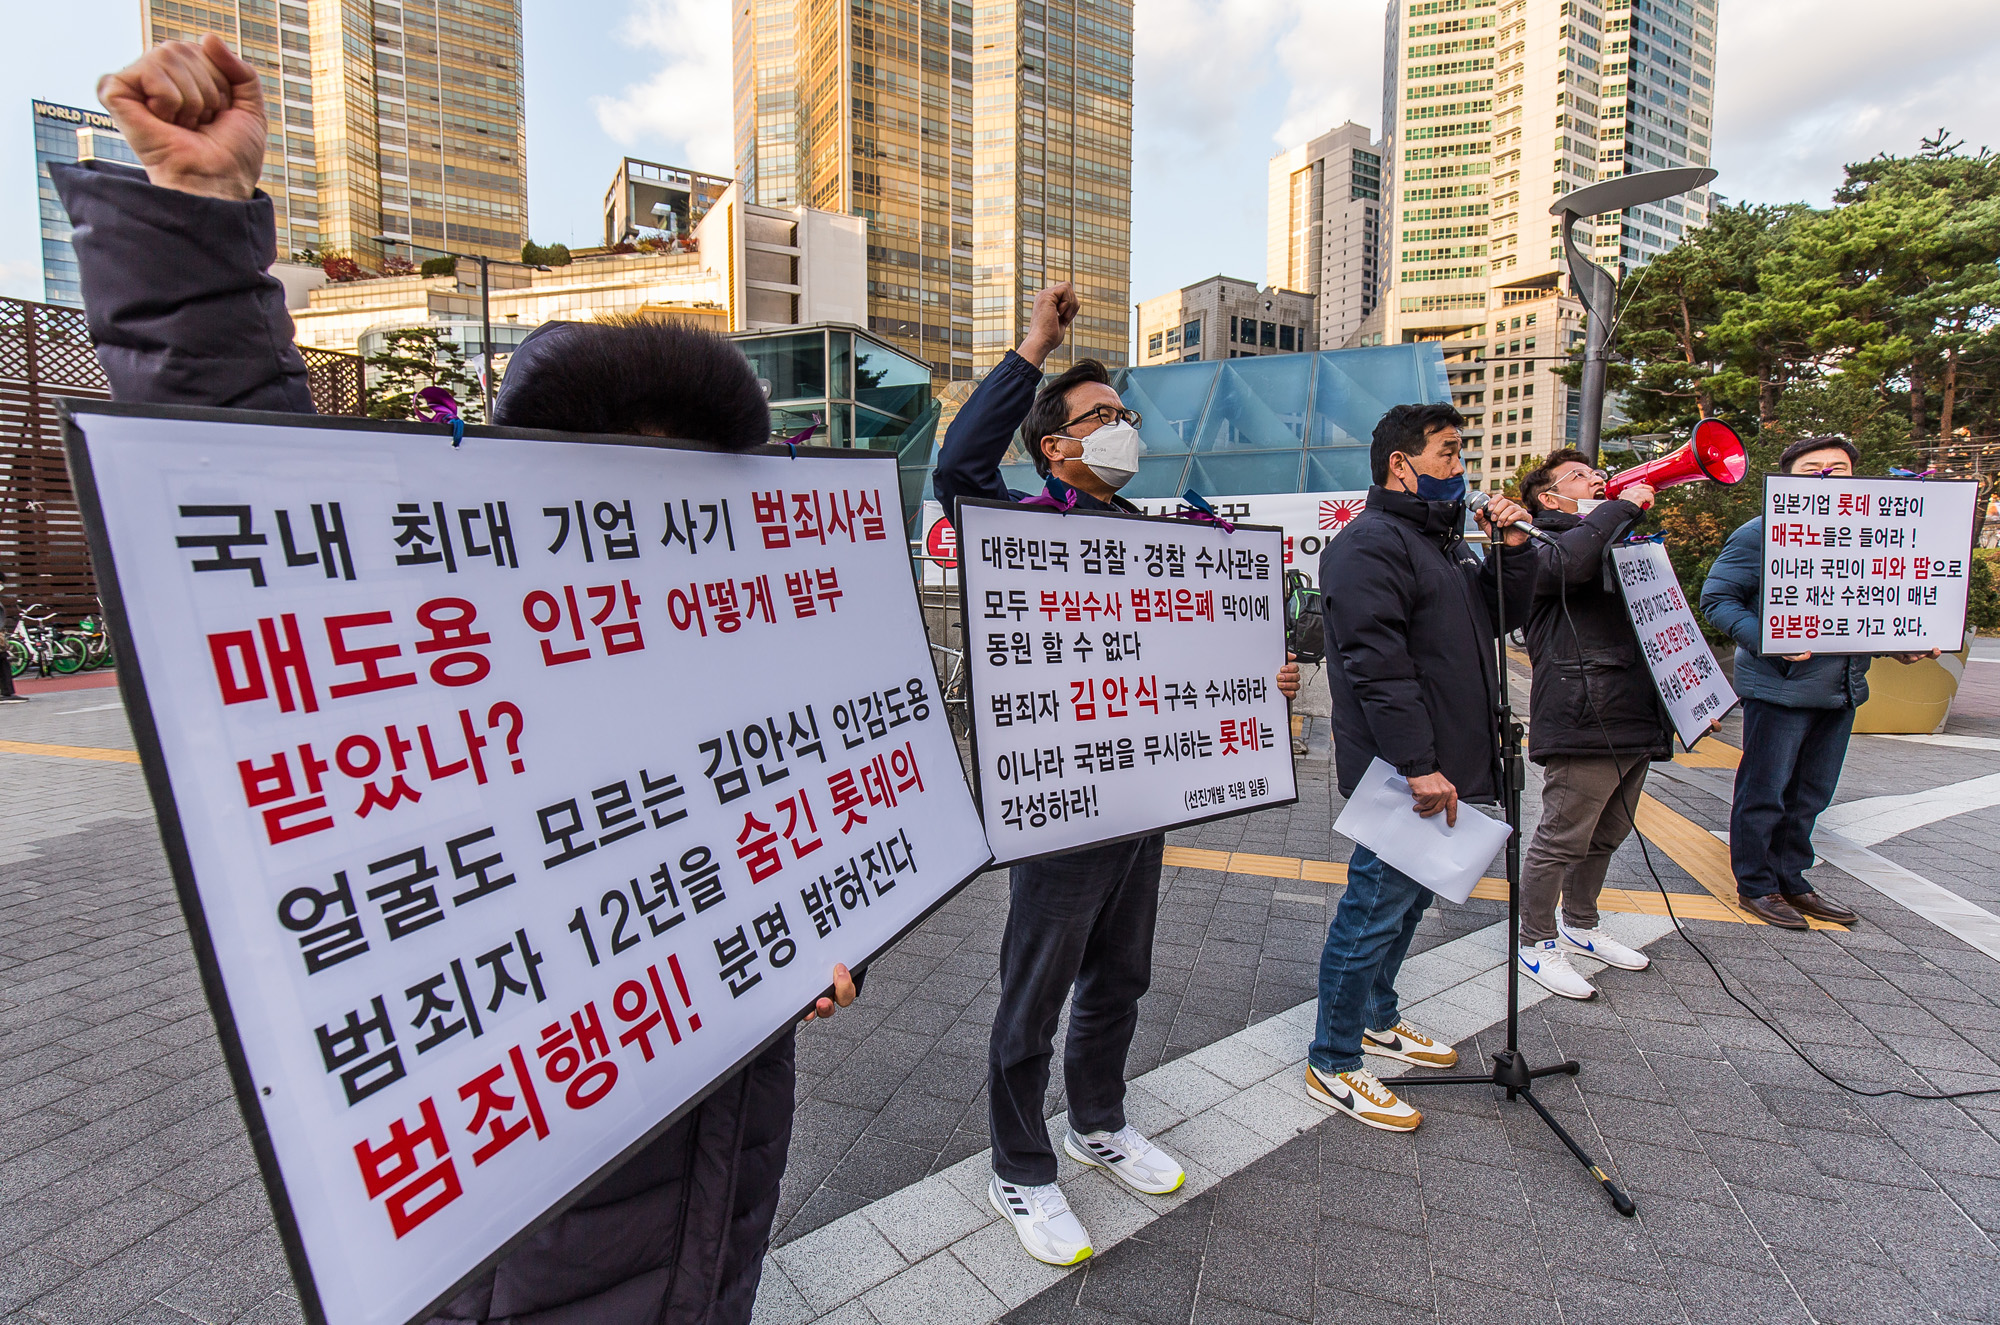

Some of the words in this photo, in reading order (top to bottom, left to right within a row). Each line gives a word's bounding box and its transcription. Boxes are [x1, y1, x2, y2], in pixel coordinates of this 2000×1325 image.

[34, 102, 81, 121] WORLD
[1773, 493, 1830, 515] 일본기업
[1838, 493, 1870, 516] 롯데
[1878, 496, 1924, 517] 앞잡이
[175, 502, 356, 587] 국내
[392, 501, 519, 573] 최대
[543, 500, 640, 562] 기업
[661, 499, 736, 554] 사기
[752, 489, 886, 549] 범죄사실
[1772, 523, 1852, 547] 매국노들은
[981, 536, 1069, 572] 대한민국
[1194, 546, 1270, 580] 수사관을
[1771, 558, 1814, 579] 이나라
[1820, 558, 1865, 579] 국민이
[1872, 557, 1906, 580] 피와
[1914, 557, 1963, 580] 땀으로
[984, 590, 1029, 621] 모두
[1039, 590, 1122, 622] 부실수사
[1130, 588, 1214, 622] 범죄은폐
[1222, 595, 1270, 622] 막이에
[1770, 586, 1799, 606] 모은
[1806, 586, 1835, 606] 재산
[1841, 586, 1900, 606] 수천억이
[1908, 586, 1937, 606] 매년
[207, 597, 491, 713] 매도용
[522, 579, 646, 667] 인감
[667, 574, 777, 637] 어떻게
[784, 567, 843, 619] 발부
[986, 632, 1032, 667] 동원
[1042, 632, 1063, 664] 할
[1073, 632, 1093, 663] 수
[1103, 631, 1141, 661] 없다
[1770, 615, 1850, 639] 일본땅으로
[1857, 617, 1885, 637] 가고
[1892, 617, 1927, 637] 있다.
[991, 690, 1059, 727] 범죄자
[1205, 677, 1267, 708] 수사하라
[237, 701, 526, 845] 받았나?
[997, 745, 1064, 785] 이나라
[1074, 737, 1135, 774] 국법을
[1144, 730, 1212, 765] 무시하는
[1219, 717, 1274, 756] 롯데는
[1001, 784, 1099, 831] 각성하라!
[1184, 785, 1225, 811] (선진개발
[1228, 782, 1246, 800] 직원
[1248, 777, 1269, 796] 일동)
[277, 826, 516, 976] 얼굴도
[536, 768, 688, 870] 모르는
[698, 704, 827, 805] 김안식
[833, 677, 931, 751] 인감도용
[313, 929, 546, 1108] 범죄자
[567, 845, 728, 967] 12년을
[736, 788, 823, 886] 숨긴
[826, 741, 925, 834] 롯데의
[353, 954, 703, 1240] 범죄행위!
[713, 902, 798, 1000] 분명
[800, 828, 919, 939] 밝혀진다
